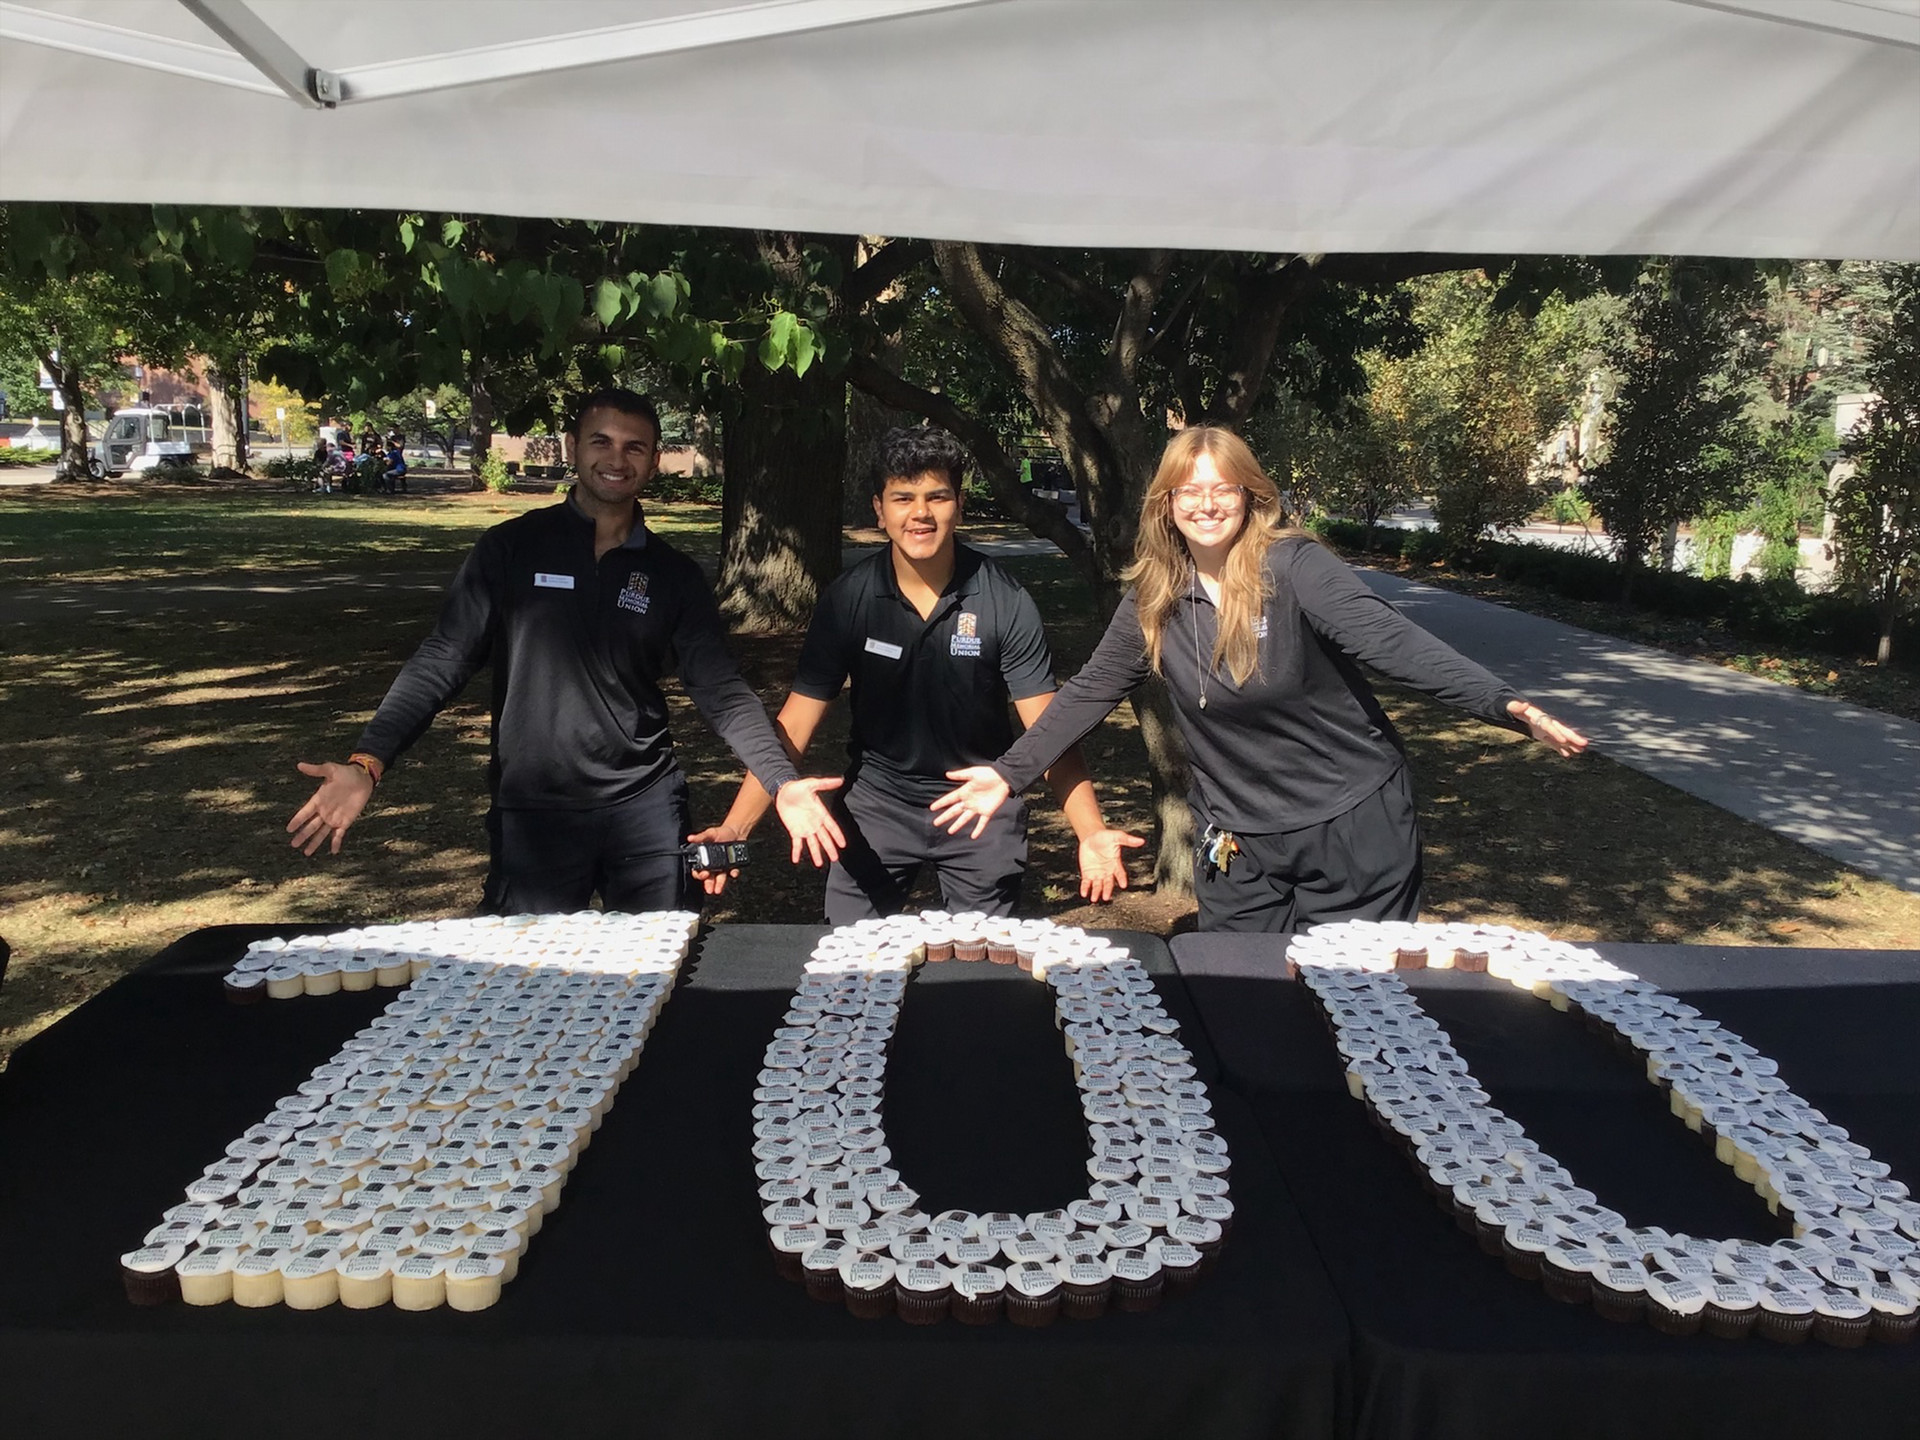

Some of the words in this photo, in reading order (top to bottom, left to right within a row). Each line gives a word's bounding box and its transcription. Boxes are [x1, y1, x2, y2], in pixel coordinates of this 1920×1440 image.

[620, 588, 650, 603] PURDUE
[617, 600, 647, 615] UNION
[951, 634, 982, 645] PURDUE
[951, 647, 980, 657] UNION
[881, 1199, 910, 1207] UNION
[774, 1213, 804, 1221] UNION
[1138, 1211, 1168, 1220] UNION
[434, 1216, 465, 1226] UNION
[829, 1217, 859, 1225] UNION
[988, 1228, 1018, 1236] UNION
[1175, 1228, 1205, 1240] UNION
[785, 1237, 816, 1246] UNION
[861, 1236, 892, 1245] UNION
[1120, 1230, 1147, 1244] UNION
[259, 1239, 291, 1248] UNION
[365, 1241, 397, 1250] UNION
[420, 1241, 450, 1251] UNION
[472, 1242, 504, 1250] UNION
[1020, 1248, 1050, 1256] UNION
[807, 1257, 835, 1265] UNION
[1162, 1254, 1194, 1262] UNION
[183, 1262, 217, 1272] UNION
[236, 1262, 270, 1272] UNION
[285, 1263, 317, 1274] UNION
[346, 1264, 379, 1273] UNION
[399, 1266, 432, 1275] UNION
[455, 1265, 488, 1274] UNION
[1071, 1271, 1104, 1279] UNION
[1116, 1267, 1149, 1277] UNION
[850, 1272, 882, 1282] UNION
[908, 1278, 941, 1286] UNION
[1023, 1280, 1057, 1291] UNION
[1671, 1290, 1702, 1303] UNION
[1717, 1293, 1752, 1302] UNION
